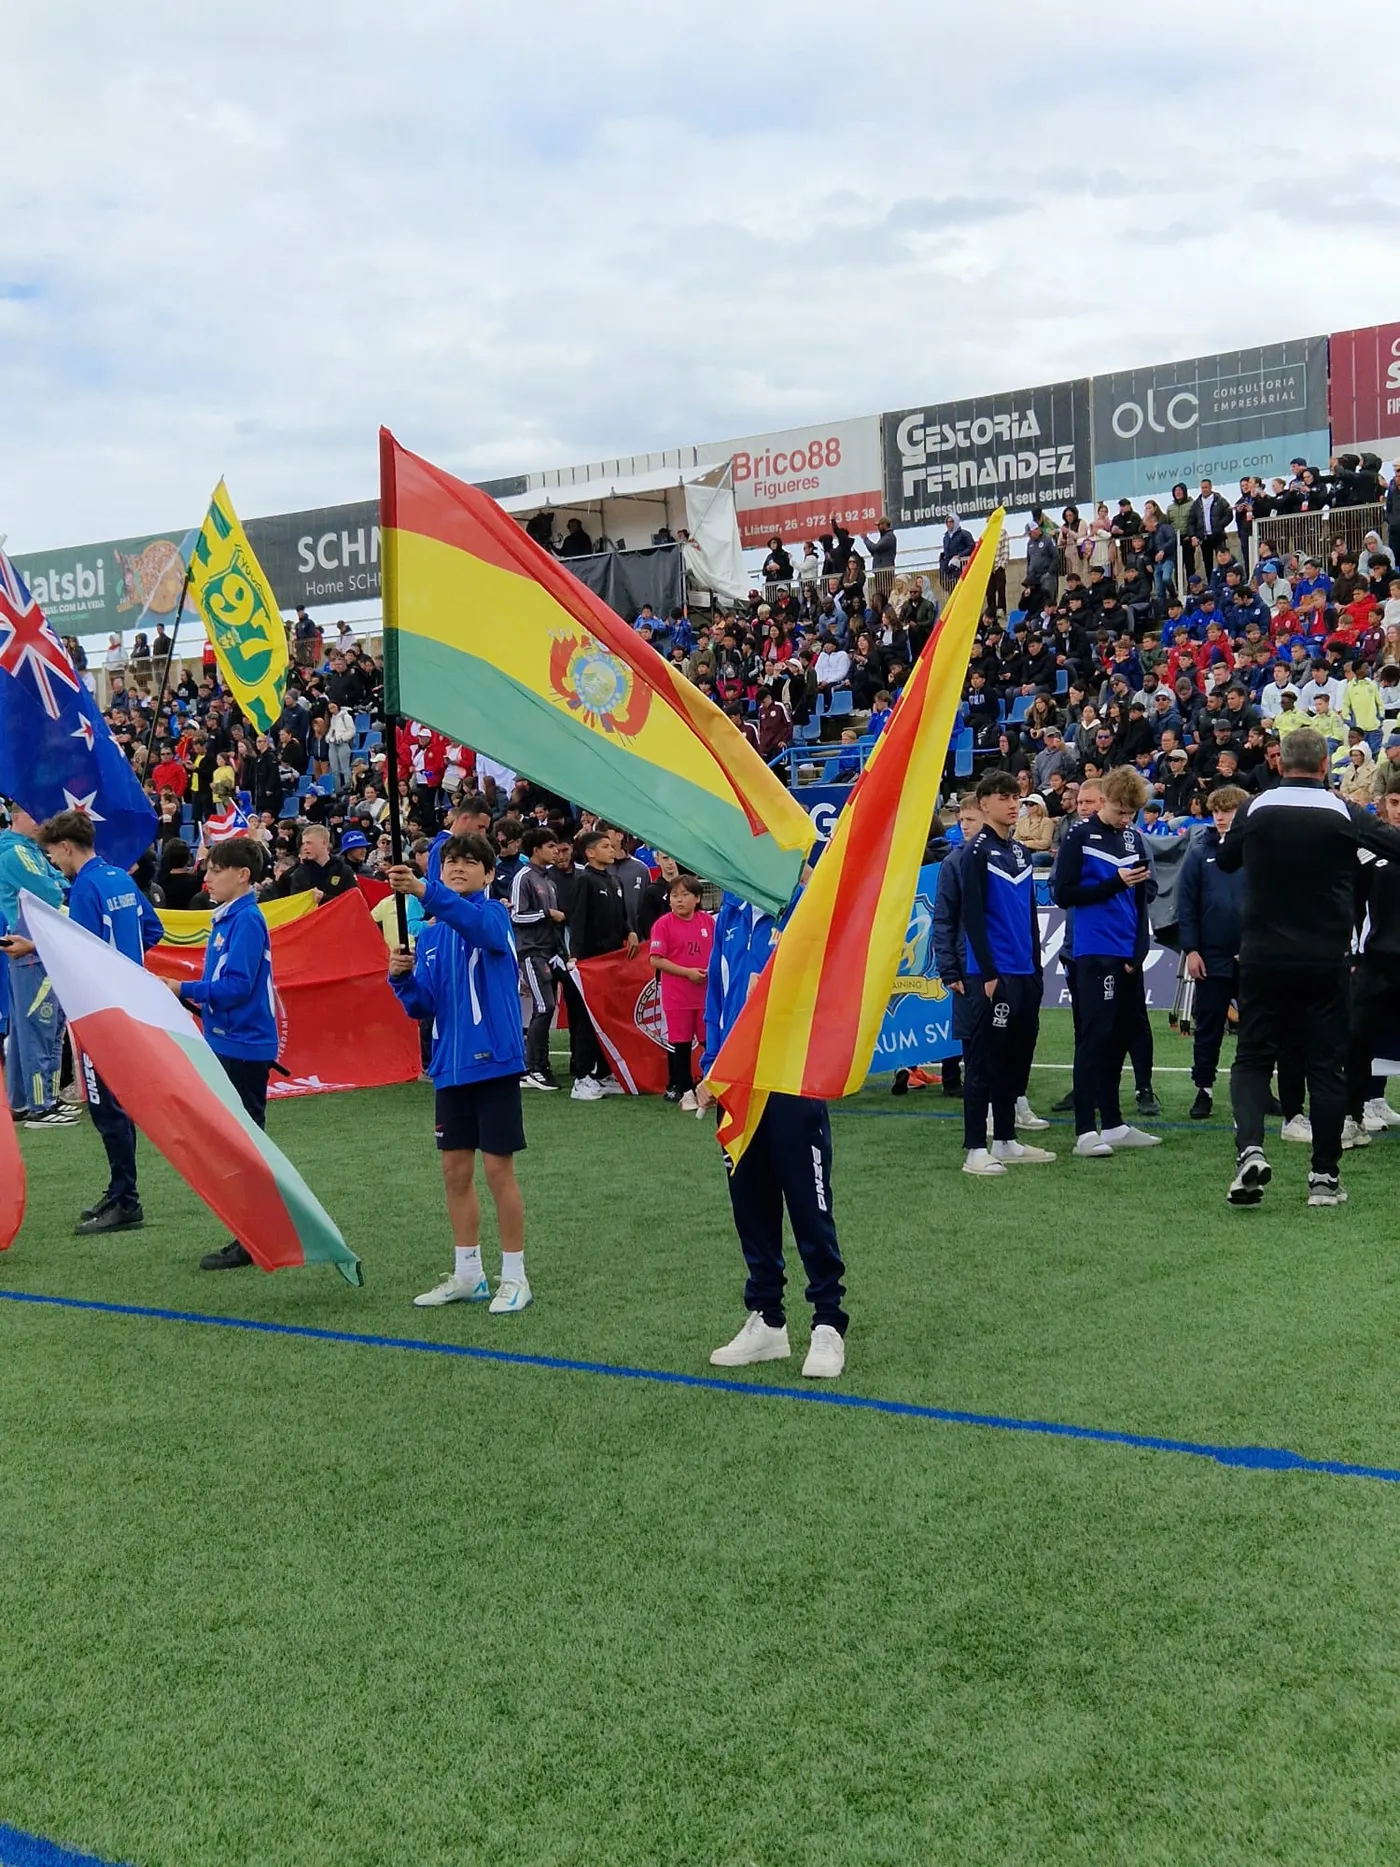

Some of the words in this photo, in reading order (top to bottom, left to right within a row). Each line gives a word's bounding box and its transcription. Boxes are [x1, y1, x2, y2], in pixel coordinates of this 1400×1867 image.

[1213, 376, 1296, 399] CONSULTORIA
[1213, 391, 1296, 413] EMPRESARIAL
[732, 437, 842, 482] Brico88
[902, 444, 1076, 498] FERNANDEZ
[1145, 452, 1274, 482] www.olcgrup.com
[754, 476, 820, 500] Figueres
[900, 508, 911, 522] la
[914, 494, 999, 523] professionalitat
[1002, 492, 1014, 507] al
[1016, 491, 1037, 506] seu
[1039, 483, 1075, 502] servei
[784, 518, 798, 531] 26
[806, 514, 826, 528] 972
[845, 510, 859, 522] 92
[861, 507, 876, 520] 38
[23, 558, 105, 605] atsbi
[306, 580, 344, 596] Home
[348, 572, 382, 591] SCH
[687, 942, 701, 956] 24
